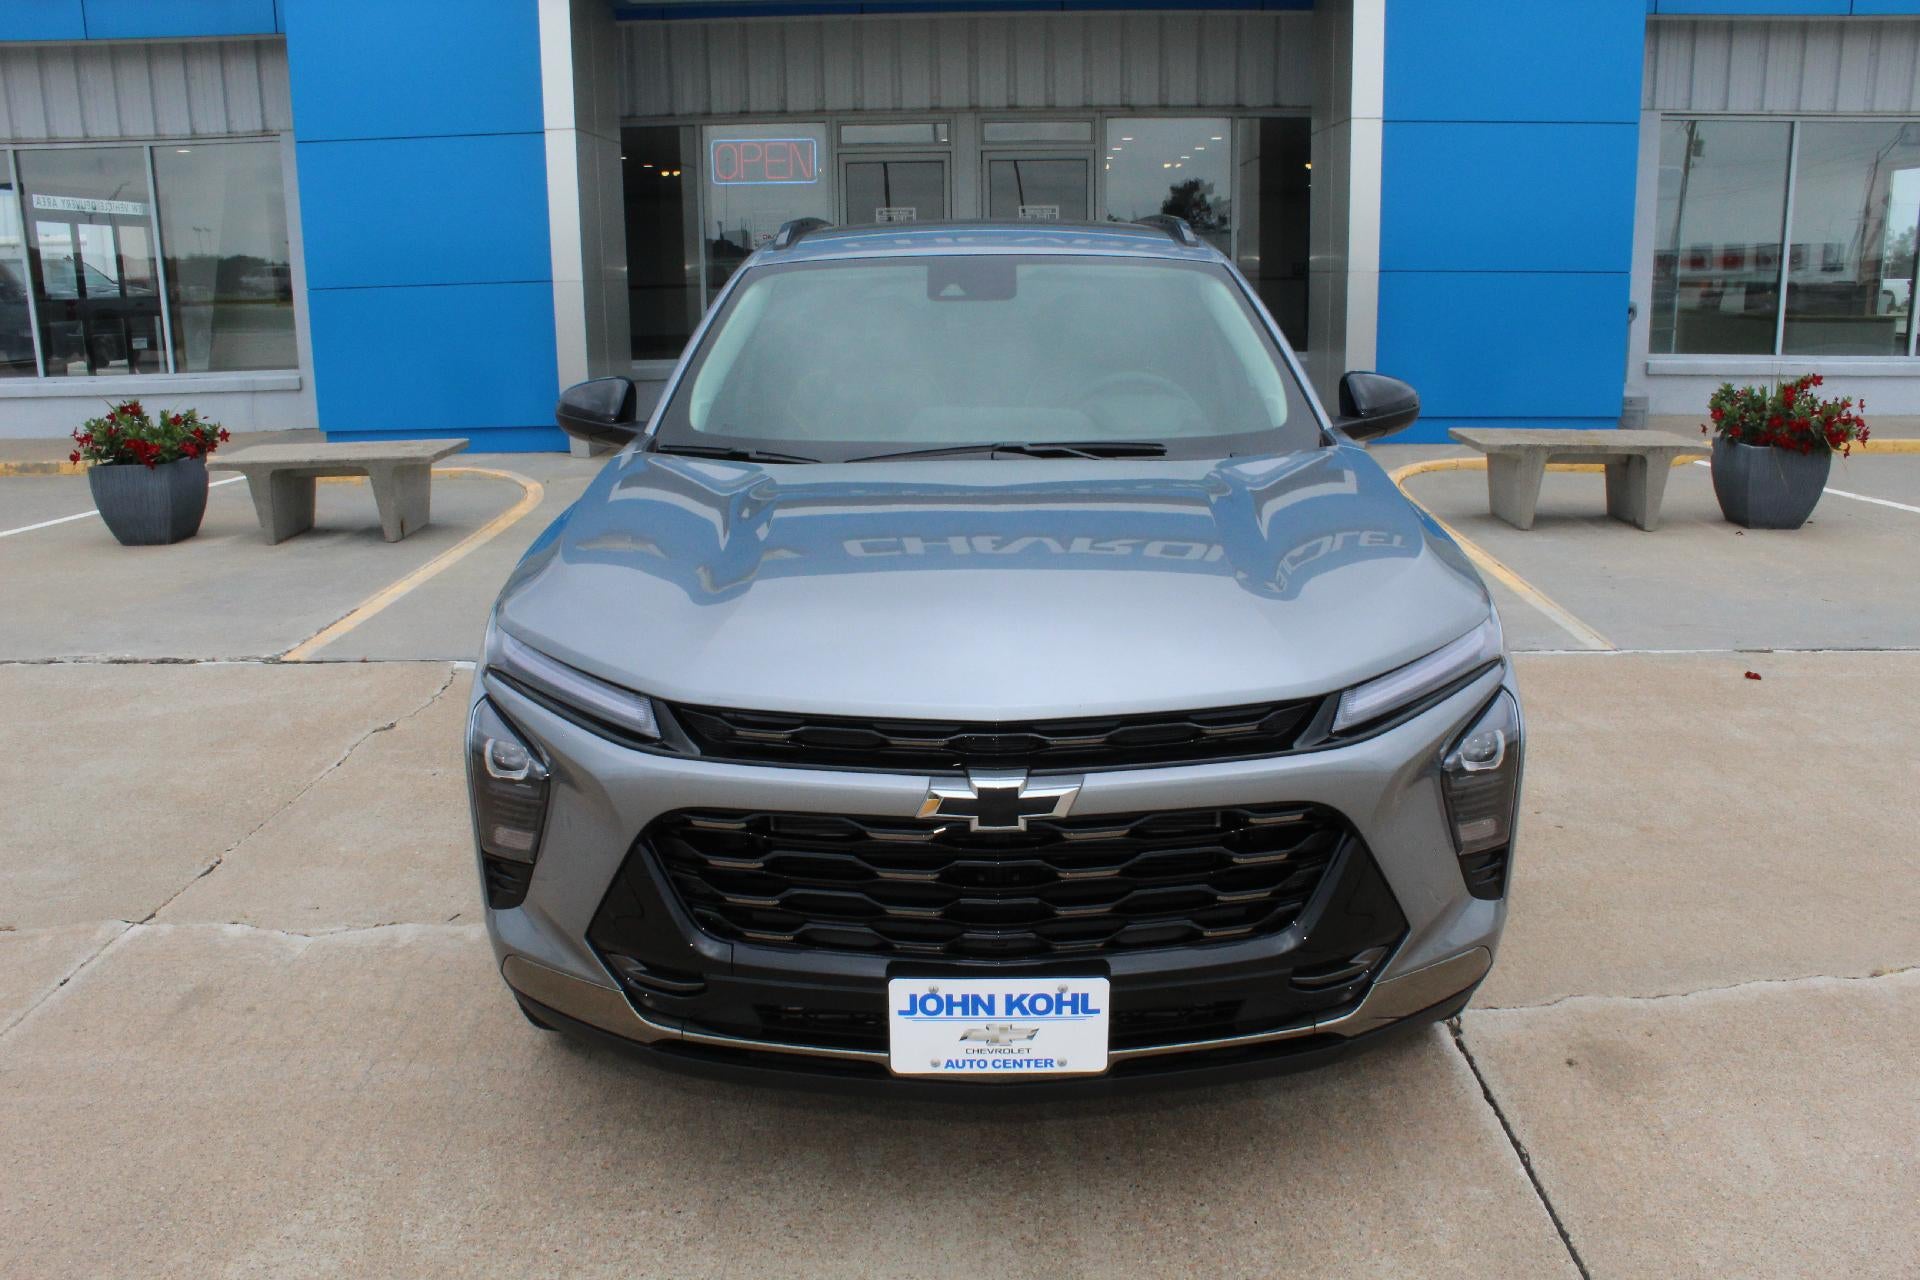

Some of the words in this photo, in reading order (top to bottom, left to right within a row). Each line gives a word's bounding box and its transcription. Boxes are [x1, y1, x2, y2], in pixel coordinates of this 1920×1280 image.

[715, 142, 812, 180] OPEN
[898, 993, 995, 1016] JOHN
[1005, 993, 1100, 1016] KOHL
[965, 1047, 1031, 1055] CHEVROLET
[944, 1058, 988, 1069] AUTO
[991, 1058, 1055, 1069] CENTER
